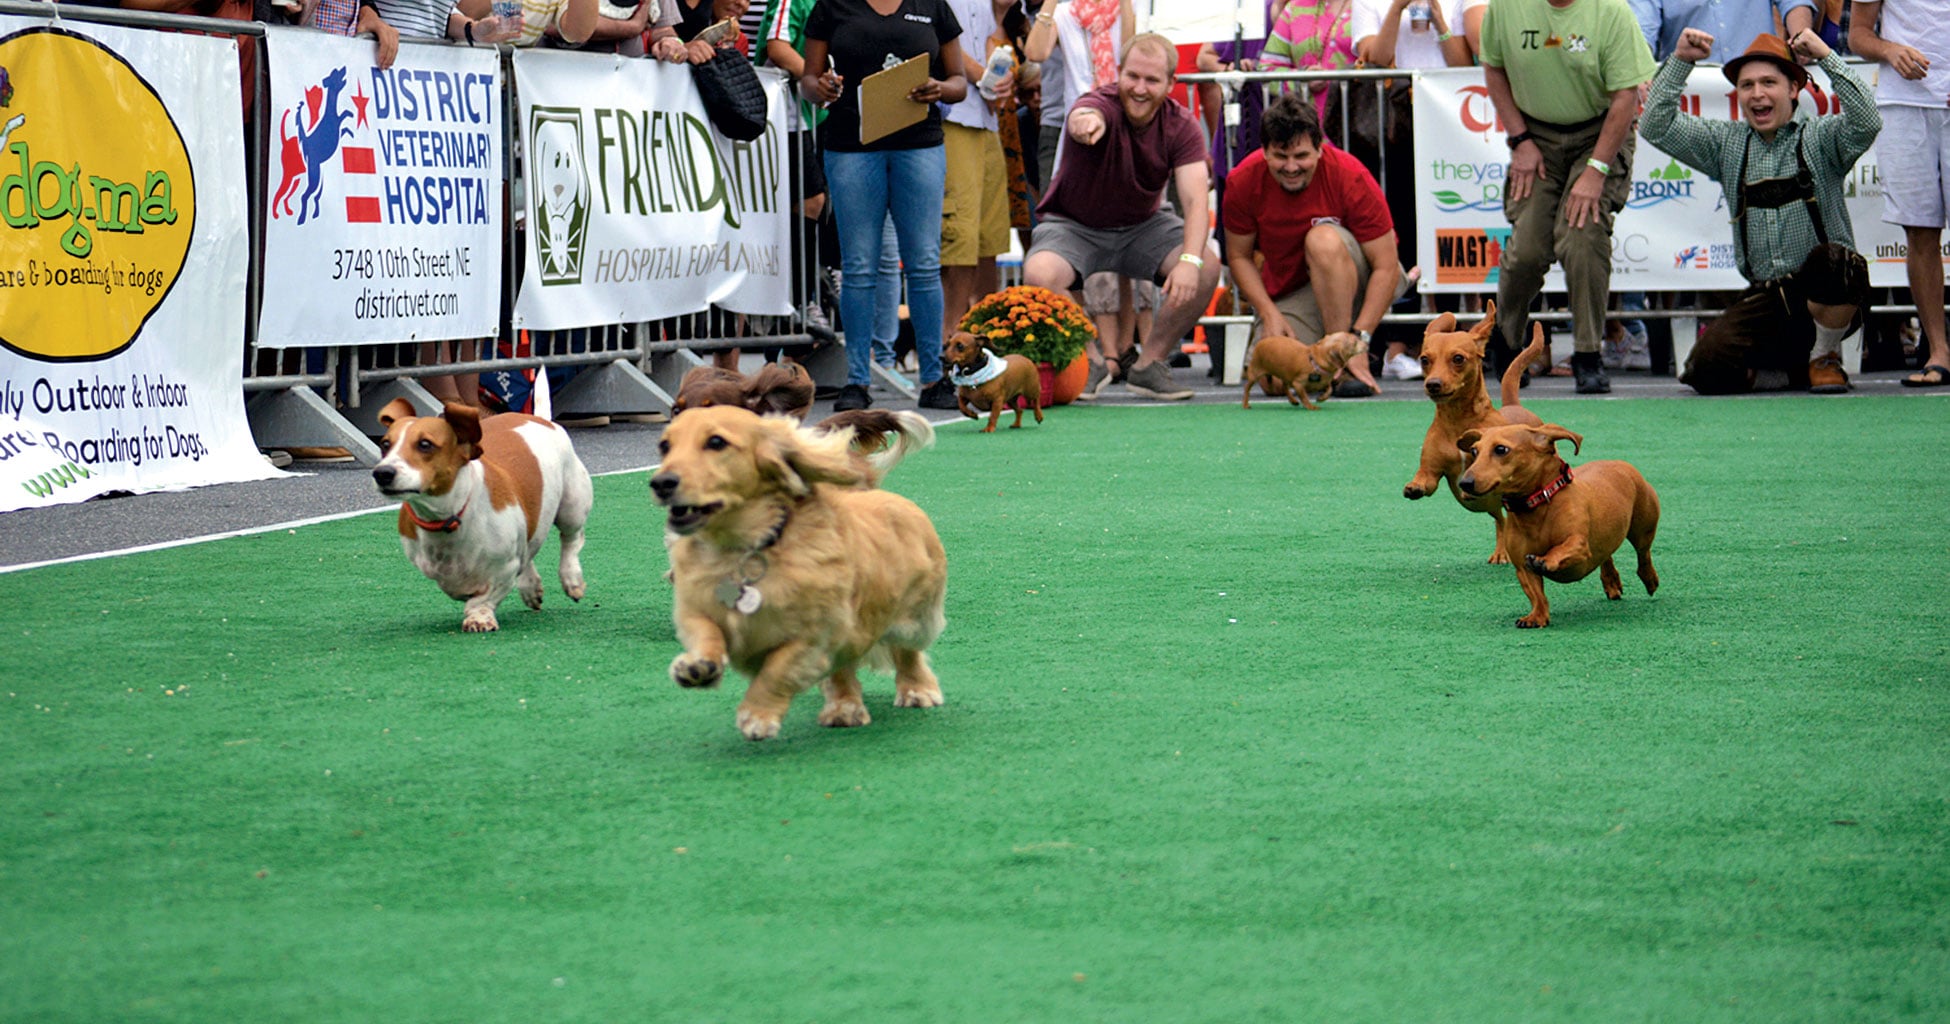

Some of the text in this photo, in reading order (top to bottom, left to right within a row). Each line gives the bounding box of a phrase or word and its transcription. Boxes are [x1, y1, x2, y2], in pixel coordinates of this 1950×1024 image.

[371, 67, 493, 124] DISTRICT
[29, 259, 40, 286] &
[43, 260, 112, 294] boarding
[128, 262, 164, 296] dogs
[332, 246, 471, 281] 3748 10th Street, NE
[595, 248, 681, 283] HOSPITAL
[355, 287, 459, 320] districtvet.com
[33, 375, 126, 414] Outdoor
[132, 373, 144, 409] &
[143, 425, 164, 460] for
